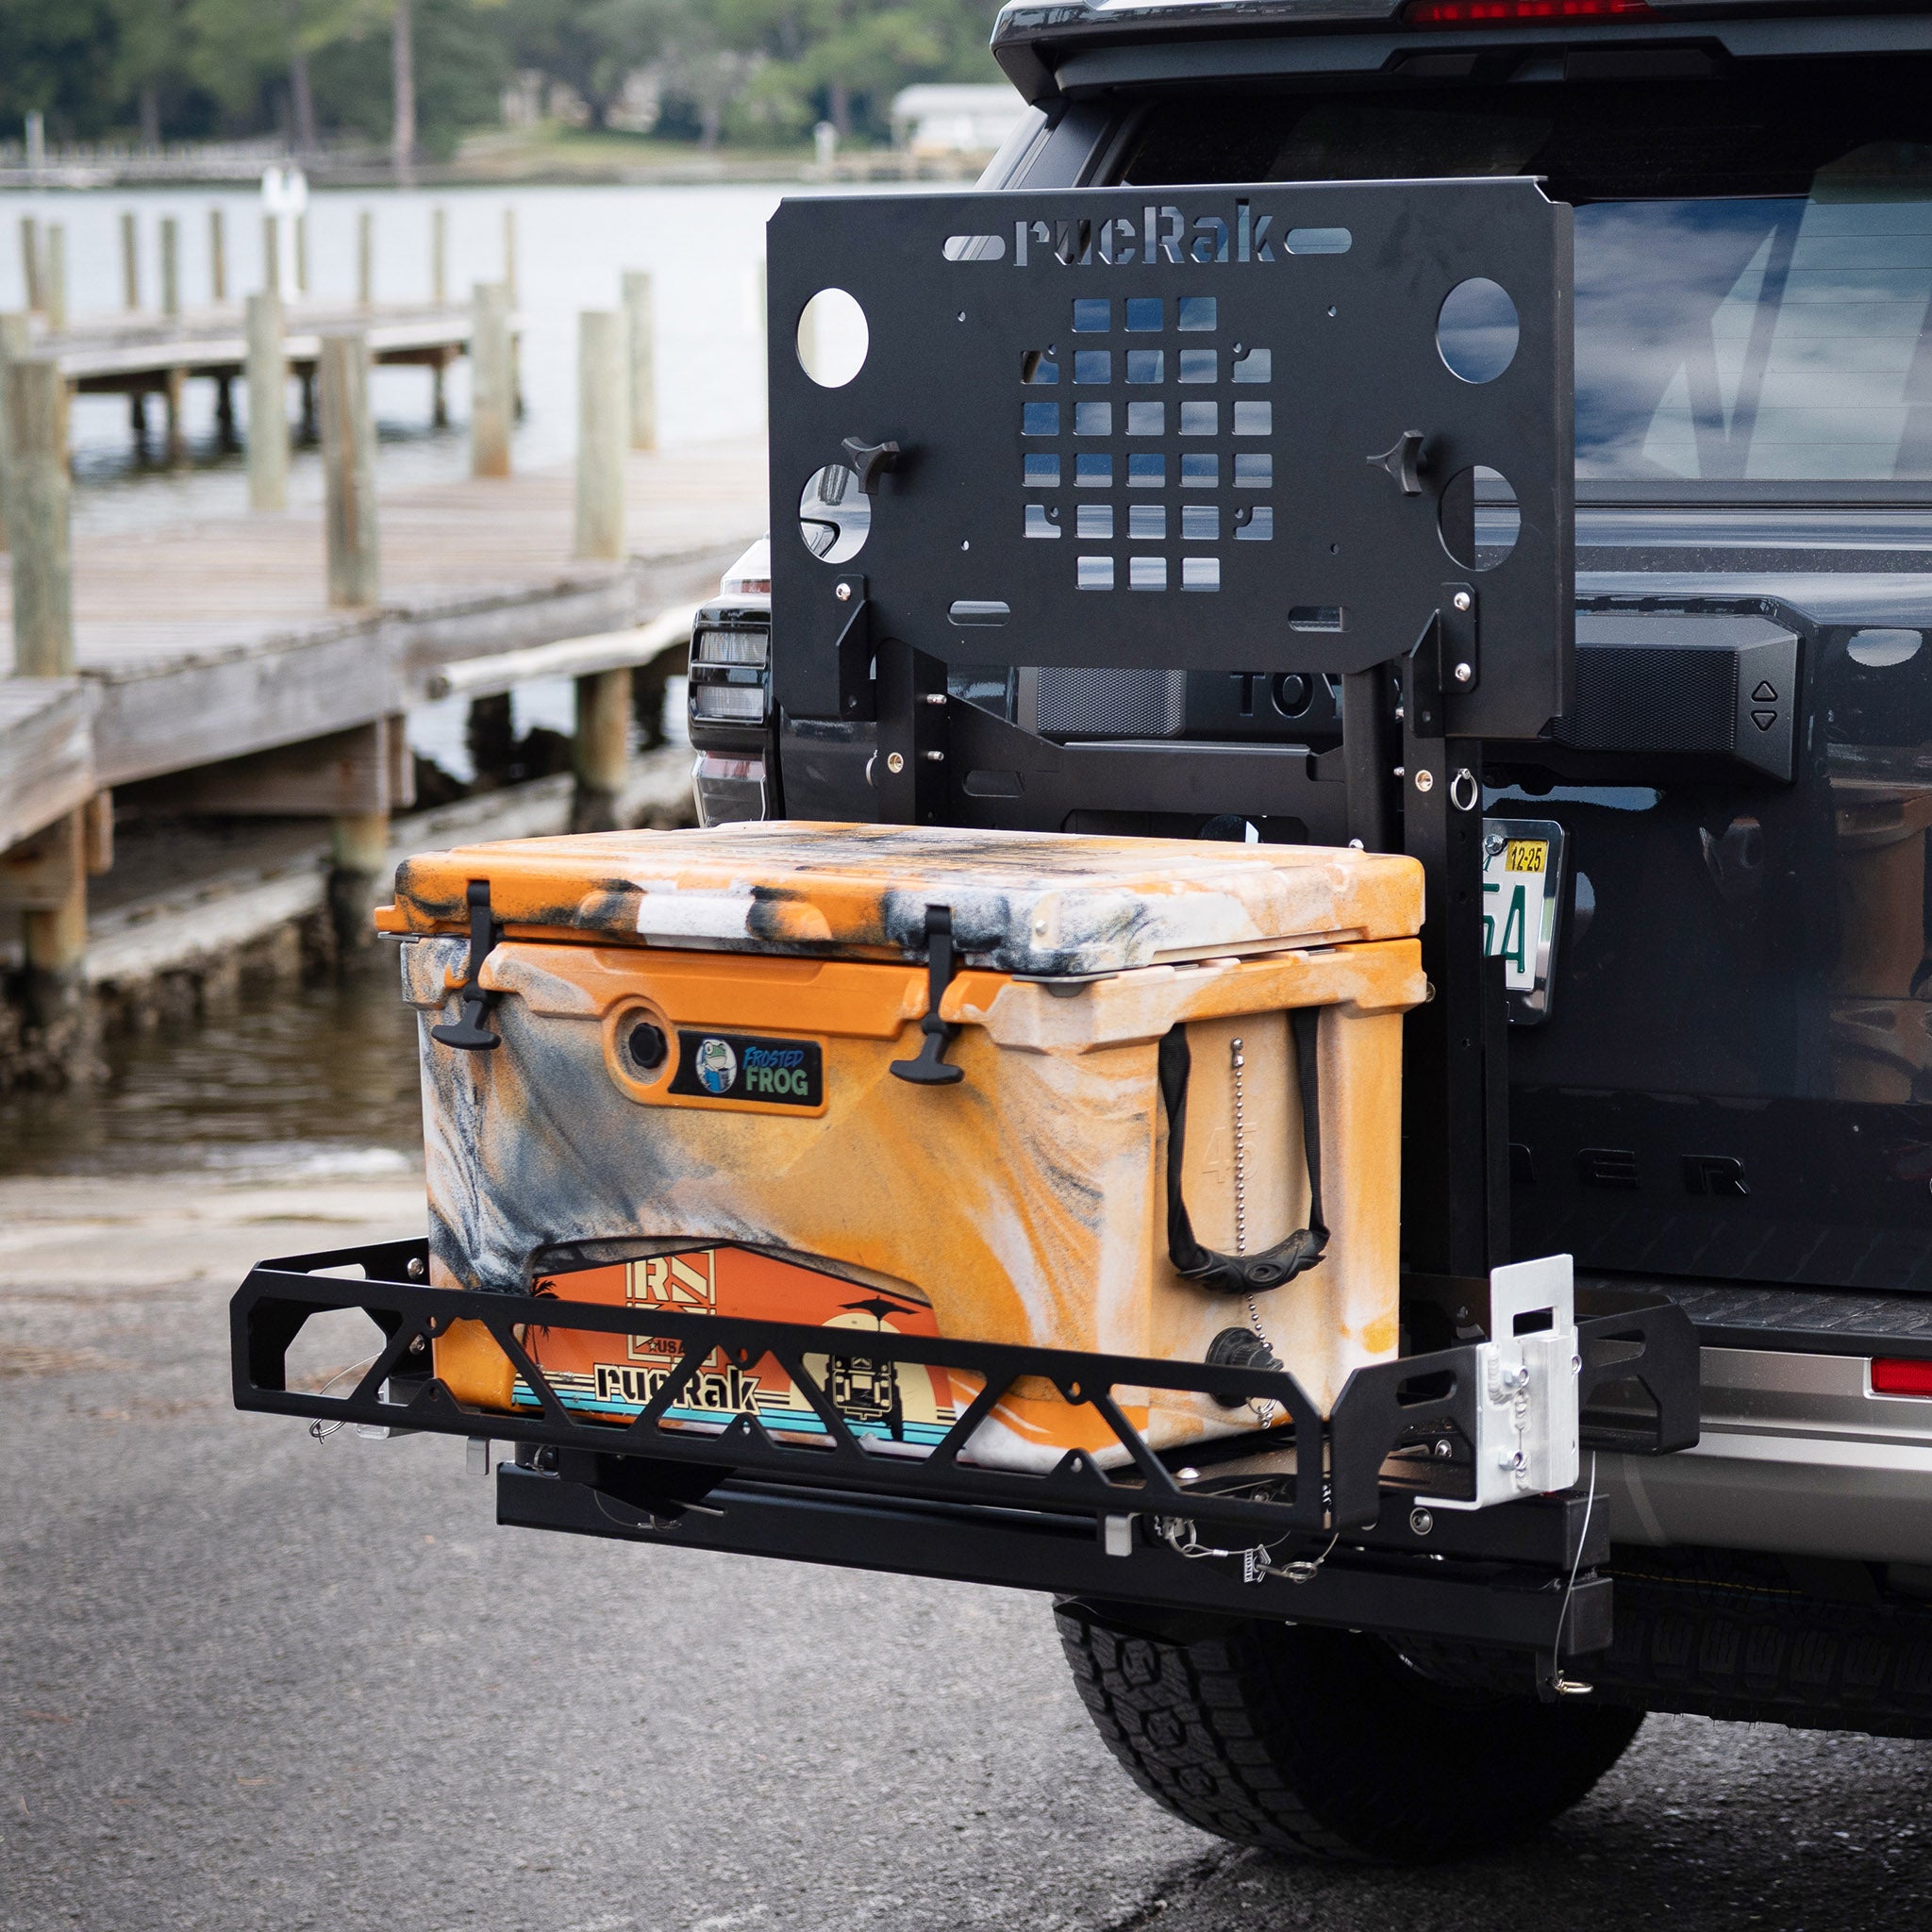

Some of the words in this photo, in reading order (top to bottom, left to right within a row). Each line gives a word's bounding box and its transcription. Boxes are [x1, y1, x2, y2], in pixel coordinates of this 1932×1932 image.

[1013, 198, 1276, 267] rucRak
[742, 1046, 805, 1070] FROSTED
[745, 1065, 808, 1096] FROG
